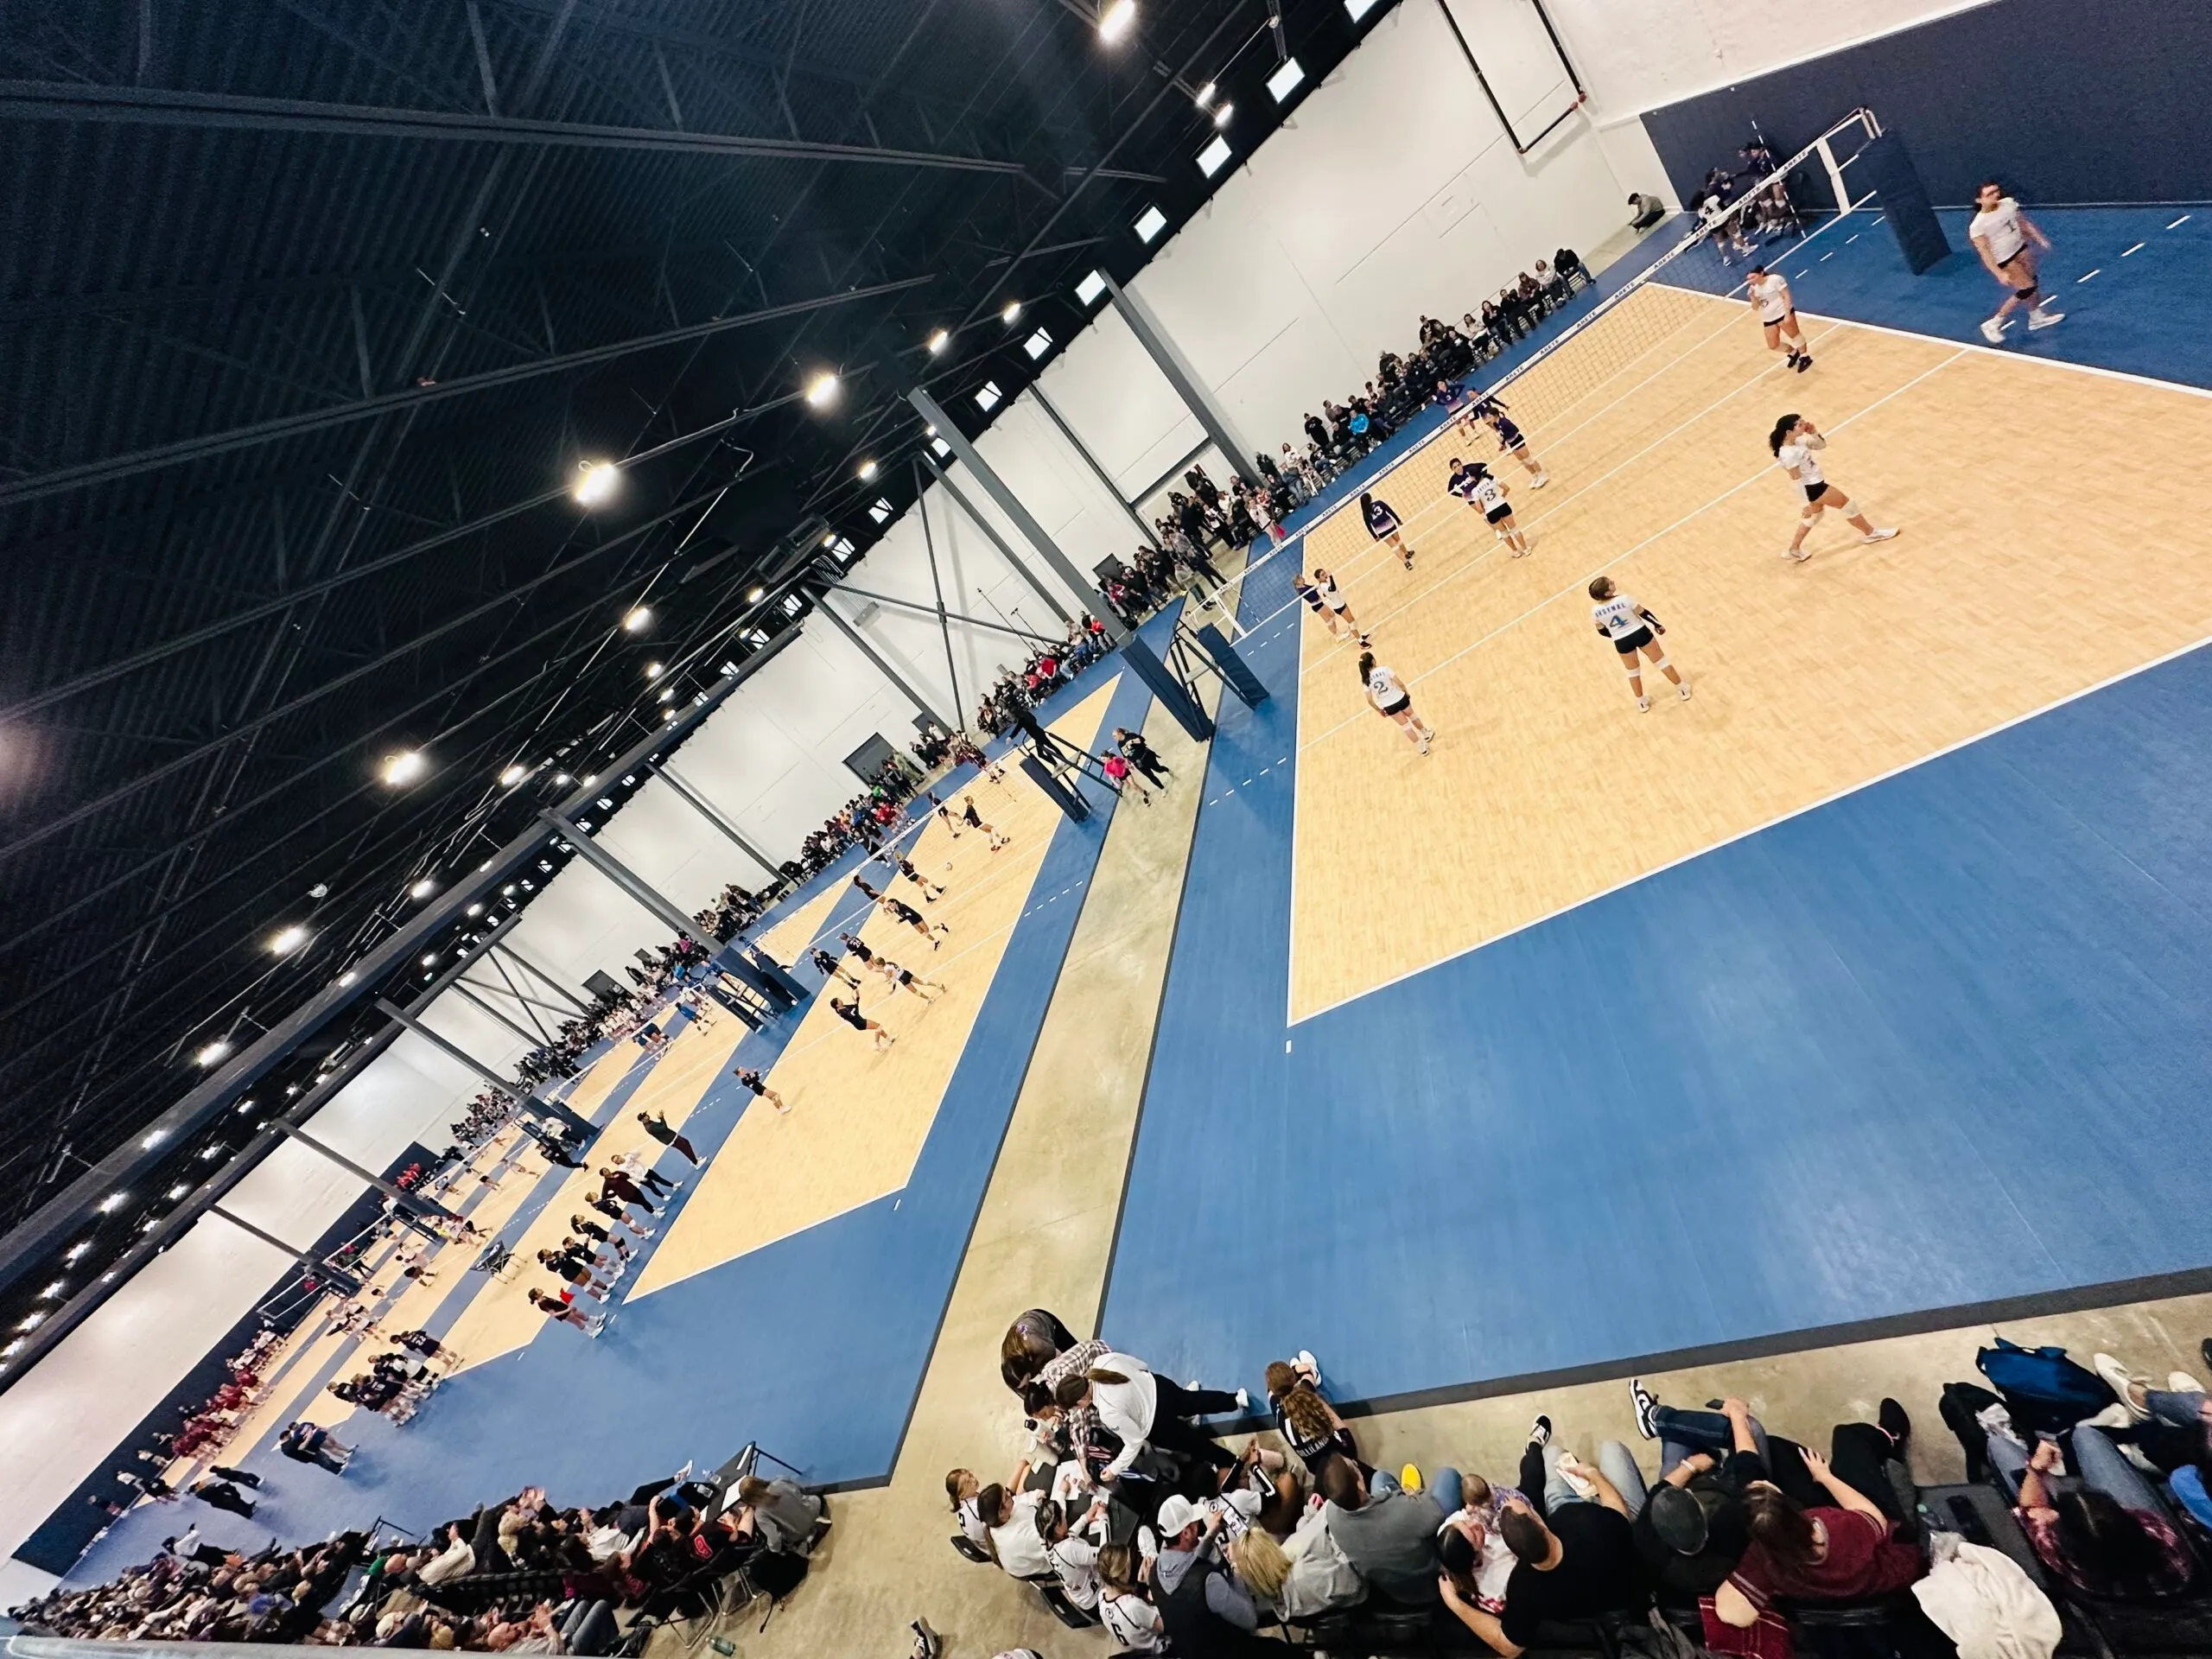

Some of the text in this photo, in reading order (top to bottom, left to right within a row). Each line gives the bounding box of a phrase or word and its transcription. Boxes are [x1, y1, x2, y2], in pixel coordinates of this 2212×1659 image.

[1704, 206, 1714, 216] 4
[1540, 340, 1560, 355] ARETE
[1576, 311, 1596, 328] ARETE
[1614, 283, 1635, 299] ARETE
[1654, 251, 1675, 269] ARETE
[1695, 220, 1717, 238] ARETE
[1738, 187, 1761, 205] ARETE
[1783, 151, 1807, 171] ARETE
[1484, 489, 1497, 501] 3
[1595, 602, 1626, 618] ARSENAL
[1610, 614, 1629, 629] 4
[1374, 681, 1389, 695] 2
